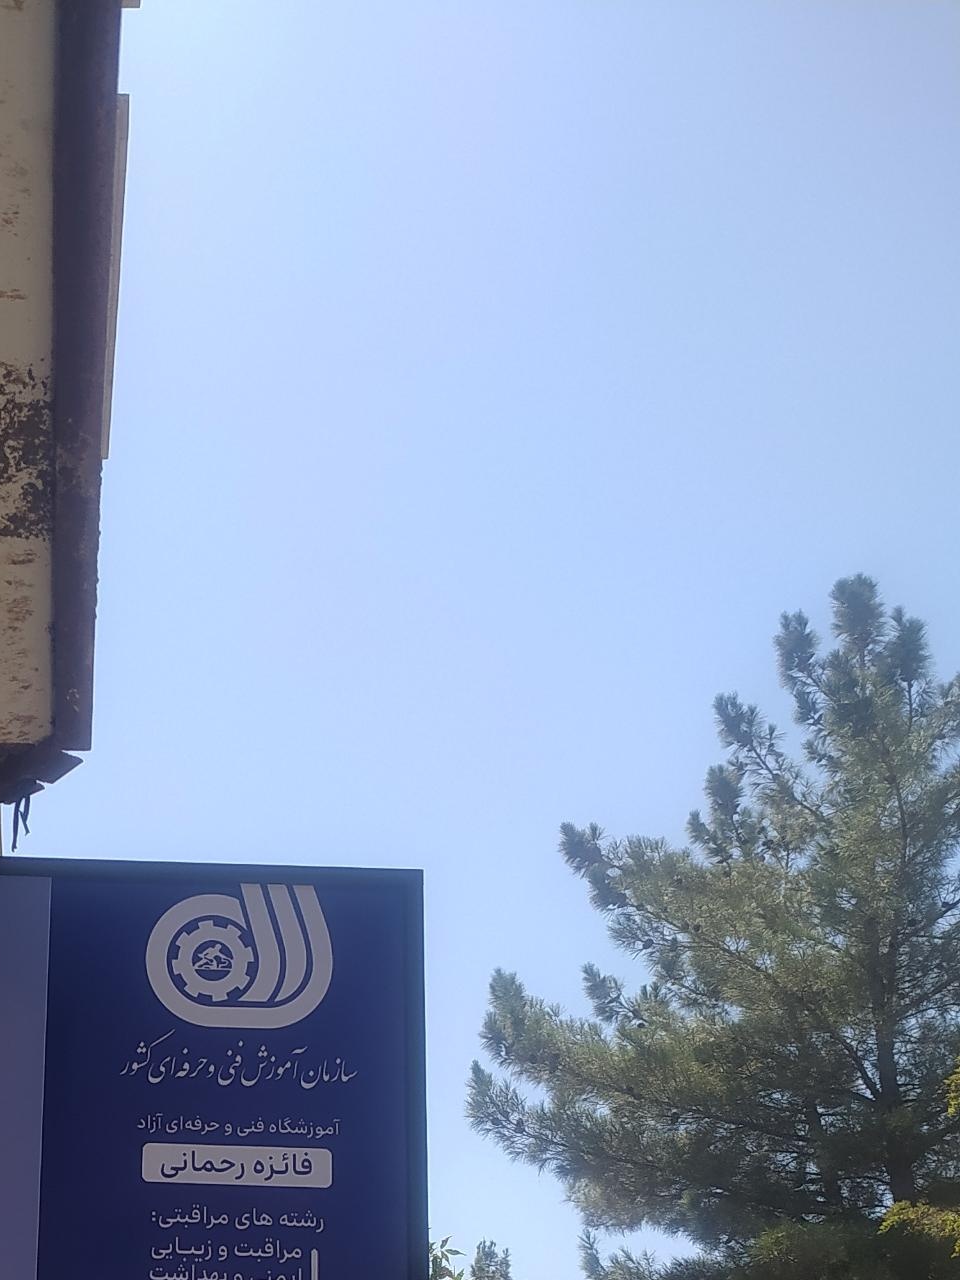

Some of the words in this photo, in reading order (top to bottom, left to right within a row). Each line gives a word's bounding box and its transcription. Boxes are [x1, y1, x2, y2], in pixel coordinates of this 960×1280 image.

[120, 1029, 176, 1076] کشور
[217, 1040, 243, 1086] فنی
[240, 1045, 308, 1087] آموزش
[300, 1057, 358, 1089] سازمان
[136, 1113, 163, 1134] آزاد
[224, 1123, 233, 1136] و
[236, 1117, 265, 1137] فنی
[269, 1119, 340, 1139] آموزشگاه
[160, 1150, 245, 1180] رحمانی
[253, 1152, 313, 1181] فائزه
[151, 1204, 229, 1229] مراقبتی:
[235, 1208, 273, 1230] های
[279, 1210, 324, 1232] رشته
[218, 1247, 228, 1260] و
[234, 1238, 302, 1263] مراقبت
